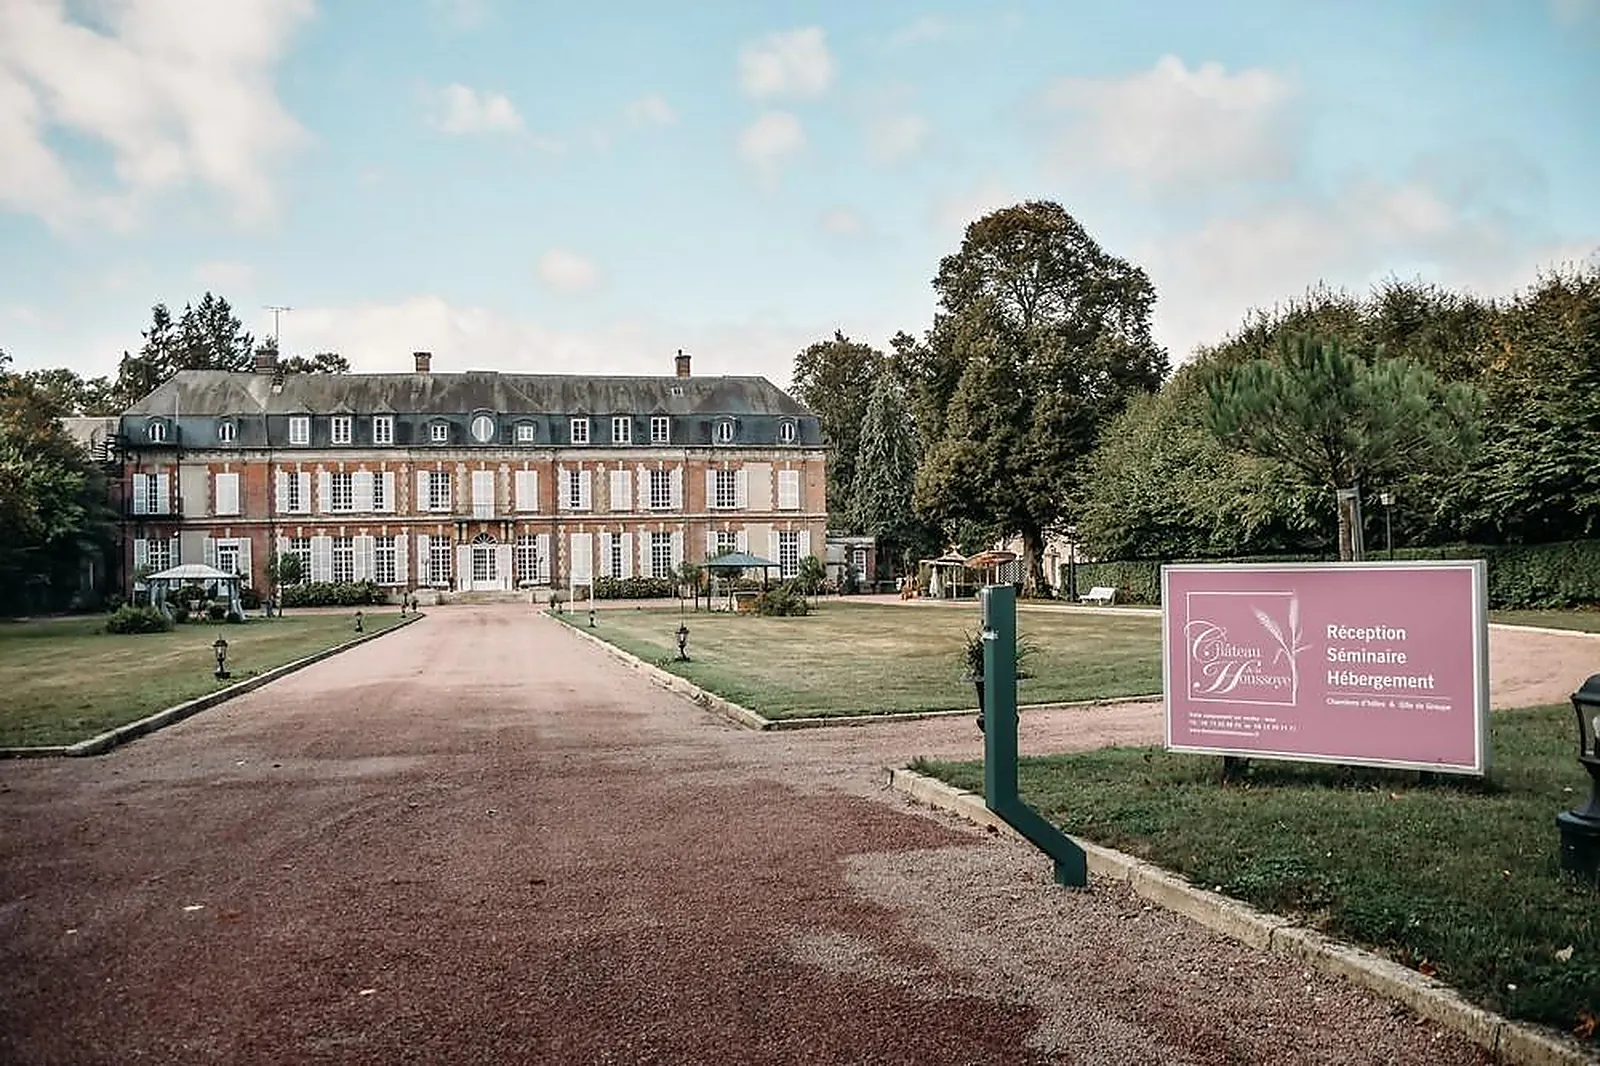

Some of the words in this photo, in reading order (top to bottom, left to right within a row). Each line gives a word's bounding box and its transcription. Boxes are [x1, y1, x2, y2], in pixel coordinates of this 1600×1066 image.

[1184, 620, 1261, 663] Château
[1326, 624, 1407, 643] Réception
[1326, 647, 1407, 664] Séminaire
[1327, 670, 1435, 690] Hébergement
